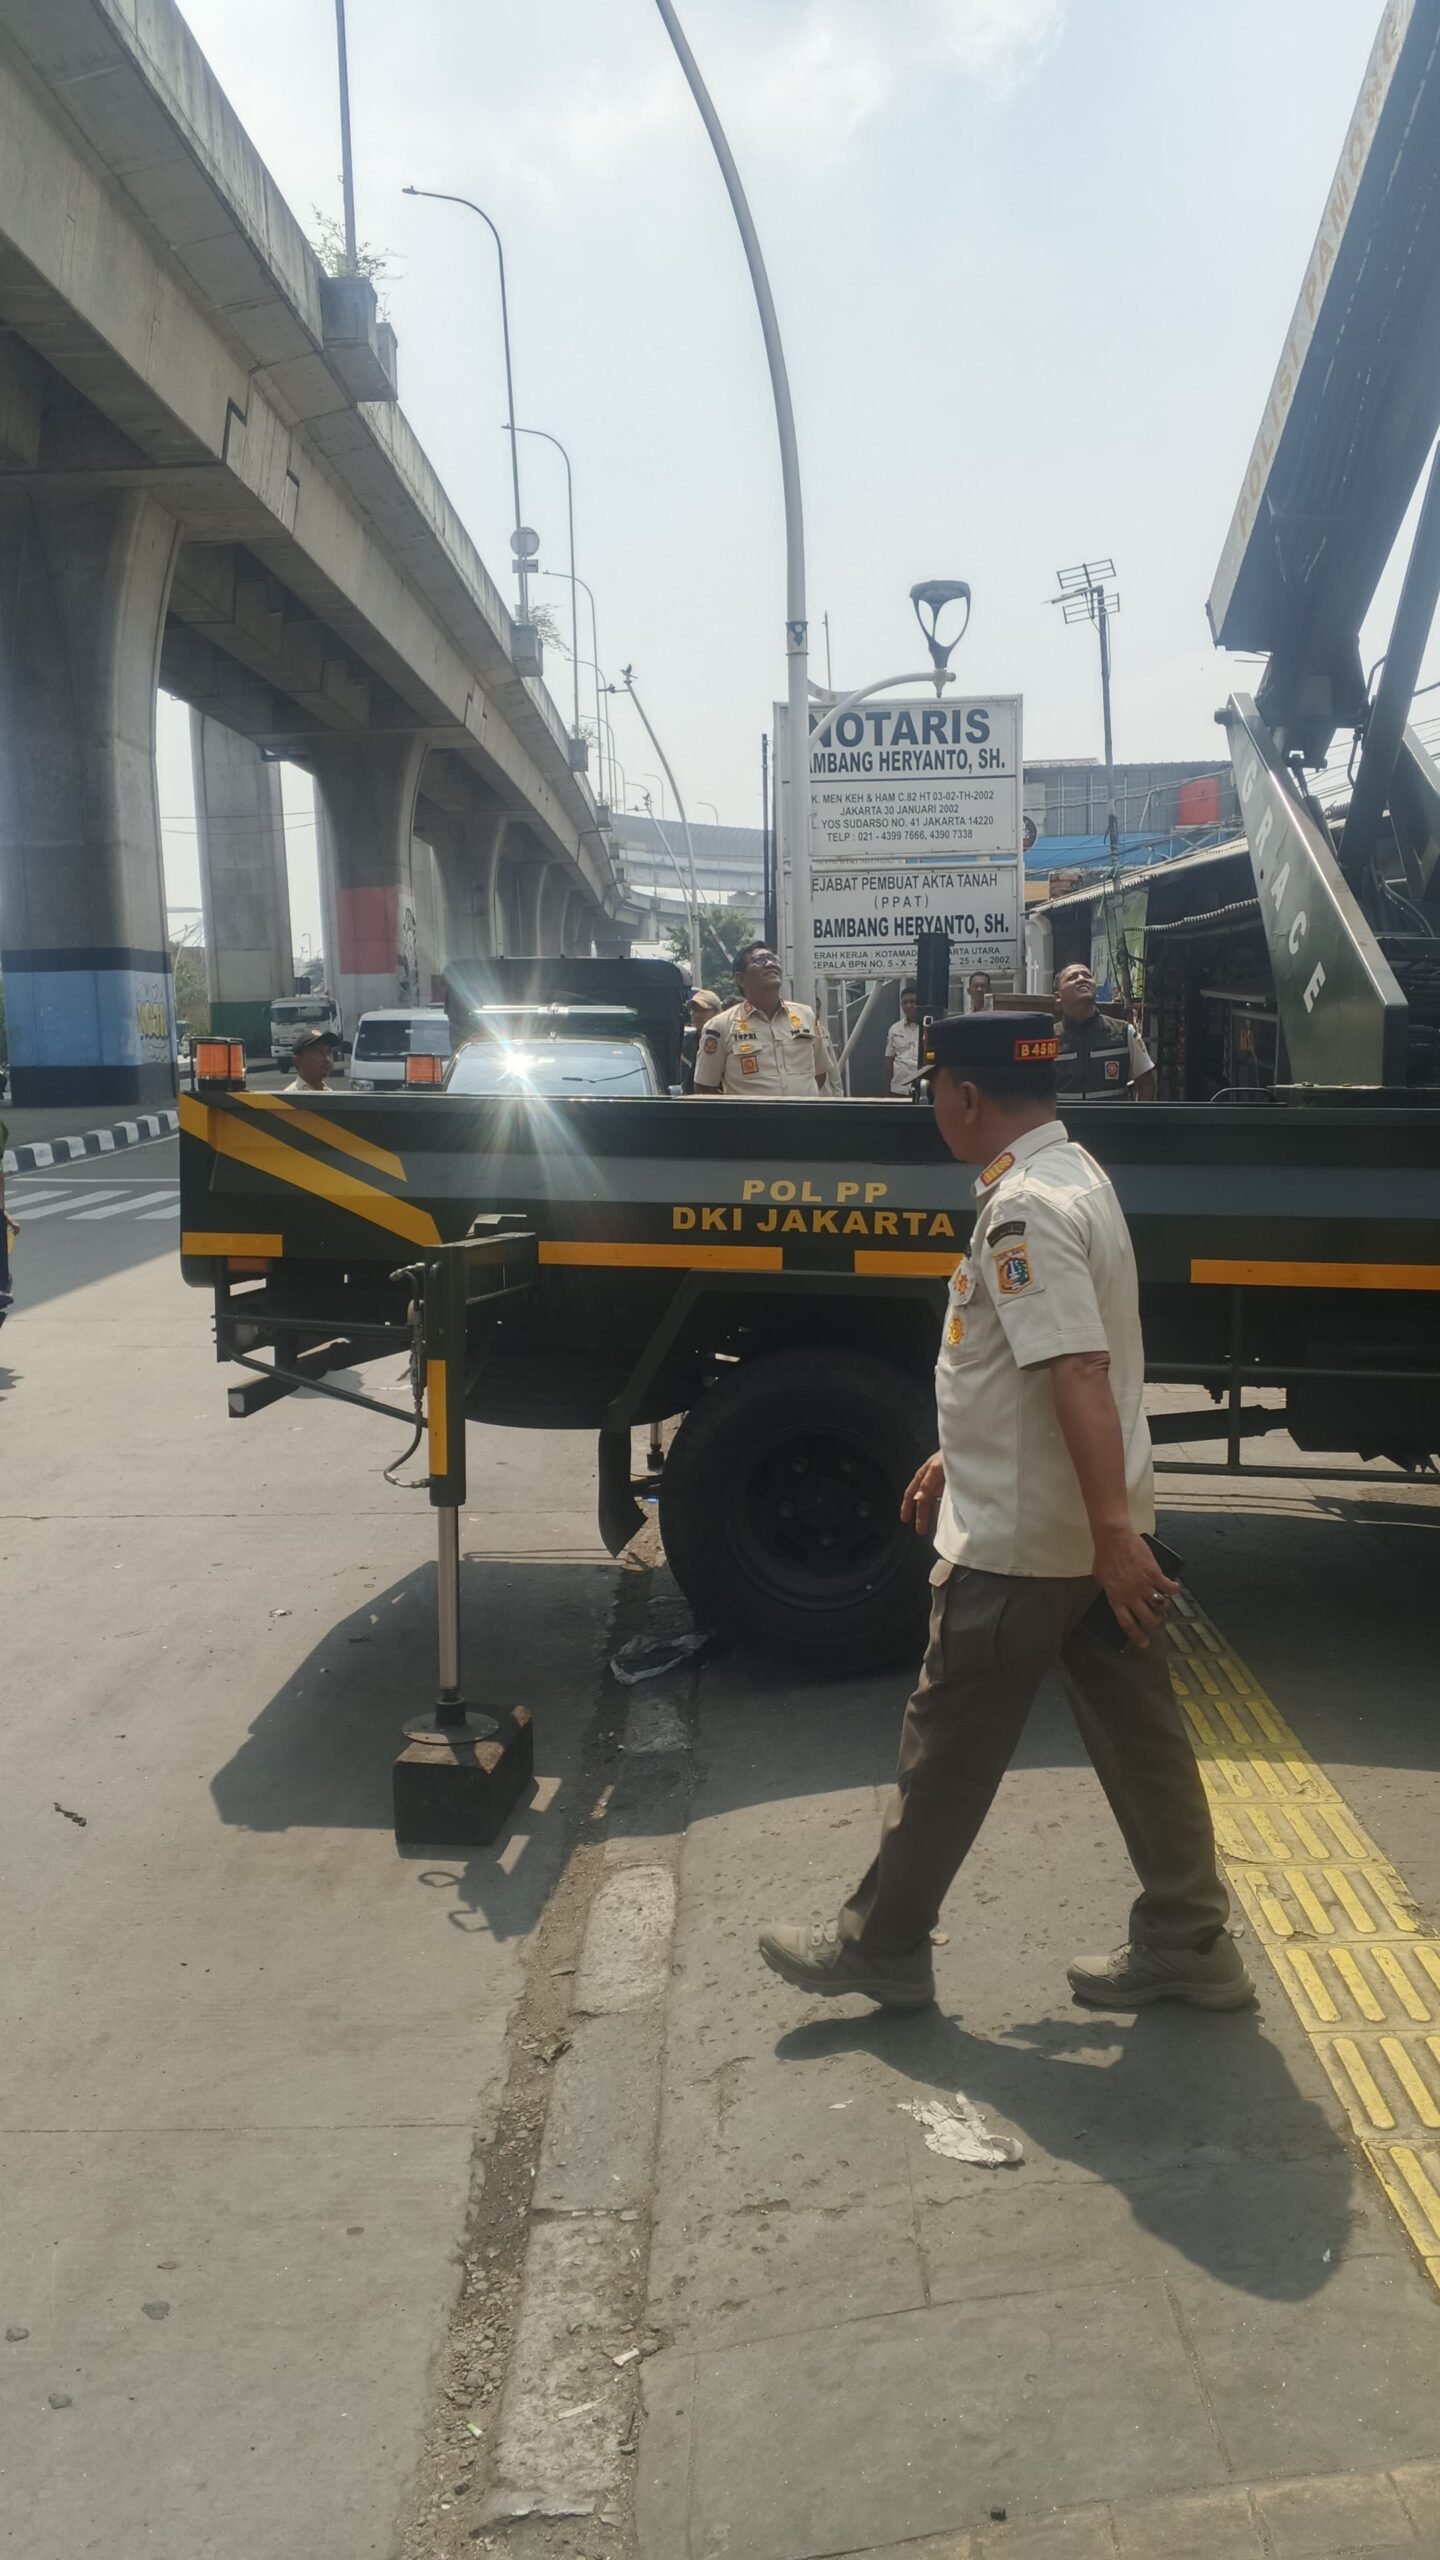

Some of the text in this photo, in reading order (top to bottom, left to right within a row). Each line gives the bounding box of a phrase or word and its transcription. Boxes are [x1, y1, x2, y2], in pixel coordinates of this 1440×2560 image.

[1238, 337, 1300, 539] POLISI
[809, 747, 1006, 774] MBANG HERYANTO, SH.
[822, 794, 842, 803] MEN
[845, 793, 864, 803] KEH
[866, 793, 873, 803] &
[875, 792, 896, 803] HAM
[840, 804, 959, 816] JAKARTA 30 JANUARI 2002
[821, 819, 841, 829] YOS
[843, 818, 889, 828] SUDARSO
[891, 817, 908, 827] NO.
[910, 817, 920, 826] 41
[923, 816, 966, 826] JAKARTA
[969, 816, 994, 825] 14220
[827, 833, 850, 842] TELP
[858, 833, 873, 841] 021
[881, 832, 902, 841] 4399
[904, 831, 927, 841] 7666,
[929, 830, 950, 840] 4390
[952, 829, 973, 839] 7338
[811, 873, 998, 892] EJABAT PEMBUAT AKTA TANAH
[1241, 759, 1326, 1014] GRACE
[813, 913, 1009, 938] BAMBANG HERYANTO, SH.
[814, 951, 838, 960] ERAH
[840, 951, 868, 959] KERJA
[875, 949, 917, 959] KOTAMAD
[971, 946, 1000, 955] UTARA
[959, 956, 970, 965] 25
[990, 955, 1010, 964] 2002
[848, 960, 867, 968] BPN
[869, 959, 886, 968] NO.
[742, 1179, 888, 1204] POL PP
[672, 1206, 742, 1231] DKI
[756, 1208, 956, 1237] JAKARTA
